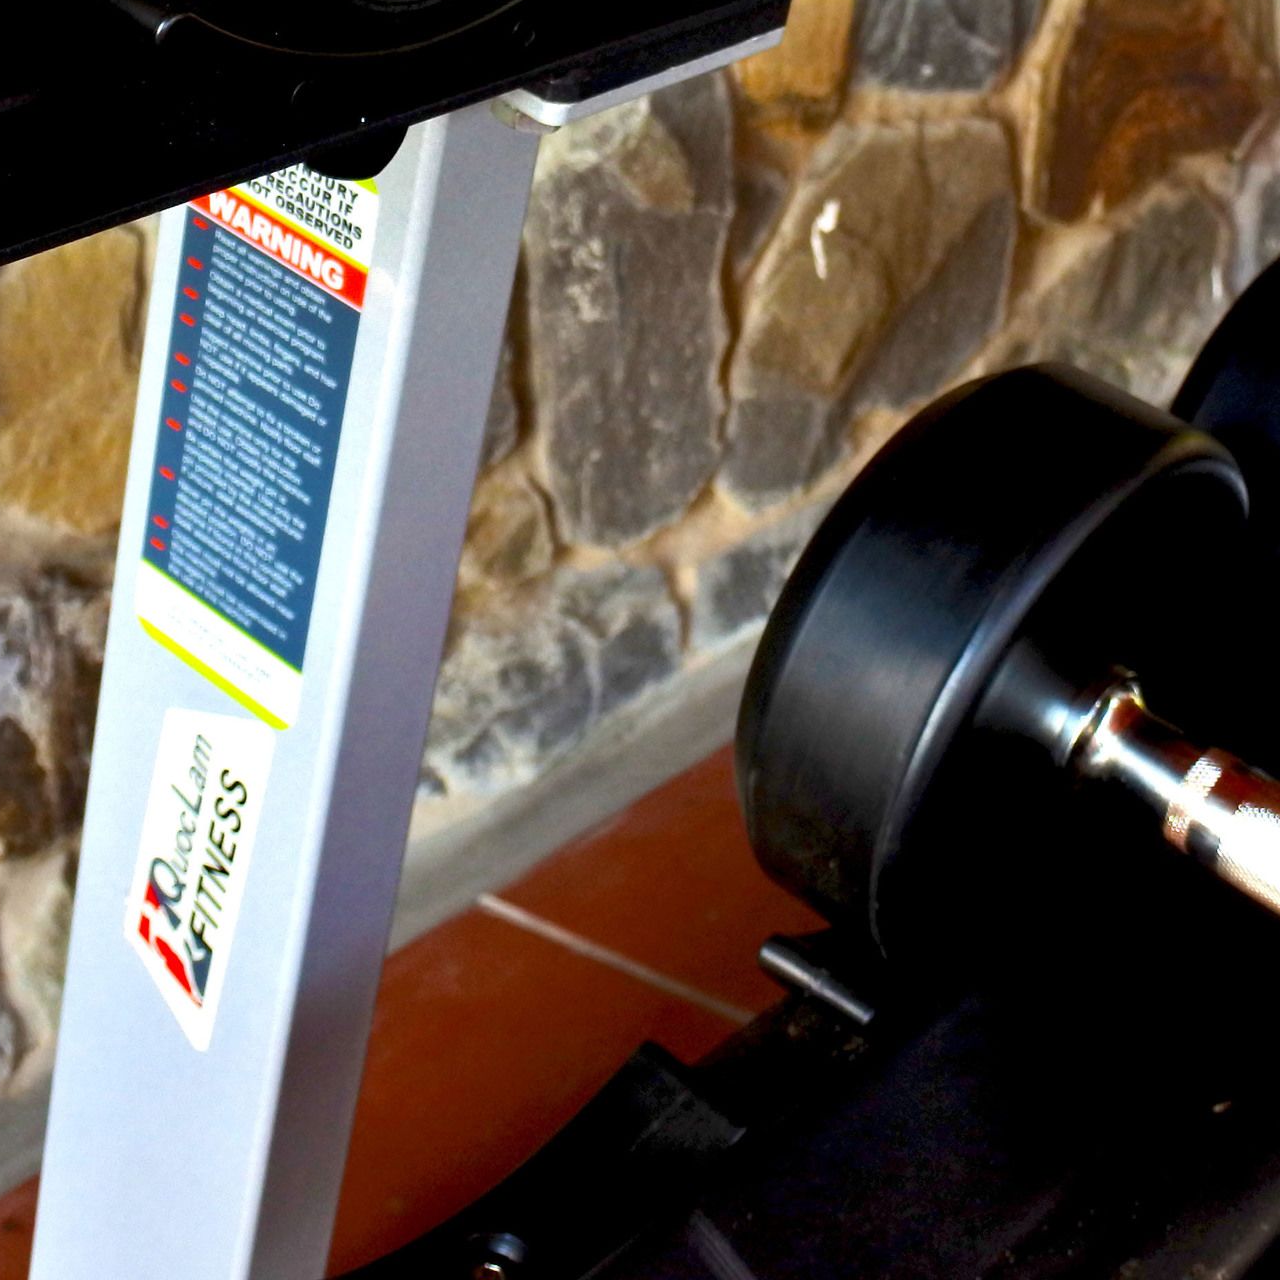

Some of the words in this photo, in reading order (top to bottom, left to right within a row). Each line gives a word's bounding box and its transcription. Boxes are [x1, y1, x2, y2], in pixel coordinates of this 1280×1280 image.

[266, 174, 363, 240] RECAUTIONS
[276, 195, 354, 250] OBSERVED
[338, 200, 354, 216] IF
[208, 191, 345, 291] WARNING
[187, 768, 248, 944] FITNESS
